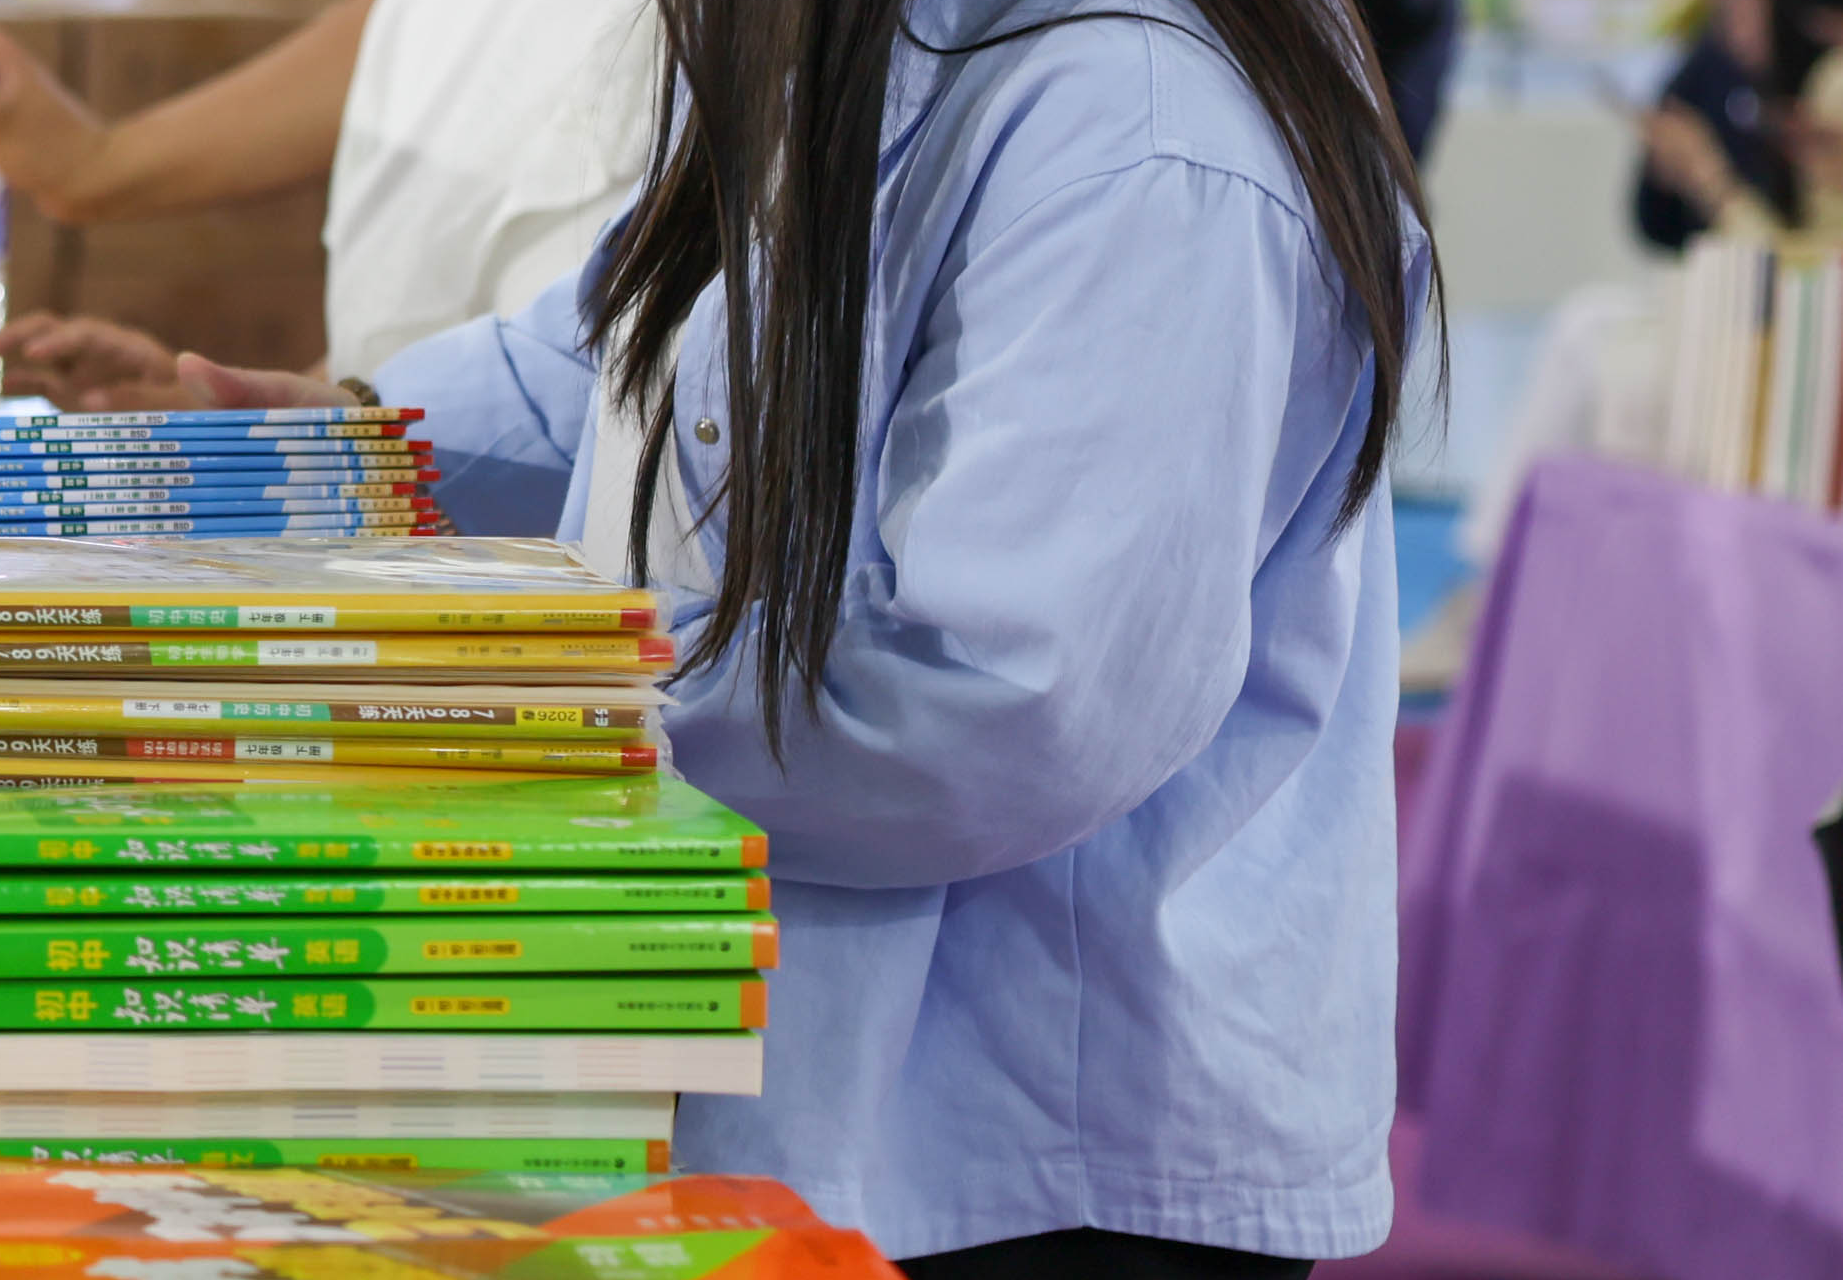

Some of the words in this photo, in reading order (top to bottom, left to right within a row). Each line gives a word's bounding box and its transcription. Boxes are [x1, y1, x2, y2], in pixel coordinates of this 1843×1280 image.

[146, 415, 163, 424] BSD
[130, 430, 147, 438] BSD
[159, 442, 176, 451] BSD
[169, 459, 186, 468] BSD
[173, 475, 190, 485] BSD
[149, 490, 165, 500] BSD
[169, 503, 186, 513] BSD
[173, 521, 190, 531] BSD
[147, 609, 229, 626] 初中历史
[248, 611, 286, 625] 七年级
[299, 611, 325, 624] 下册
[134, 701, 161, 713] 下册
[173, 702, 211, 714] 七年级
[233, 703, 312, 717] 初中历史
[520, 709, 577, 722] 2026春
[245, 743, 283, 756] 七年级
[296, 744, 322, 757] 下册
[47, 939, 111, 971] 初中
[125, 936, 291, 973] 知识清单
[35, 990, 99, 1021] 初中
[113, 987, 278, 1023] 知识清单
